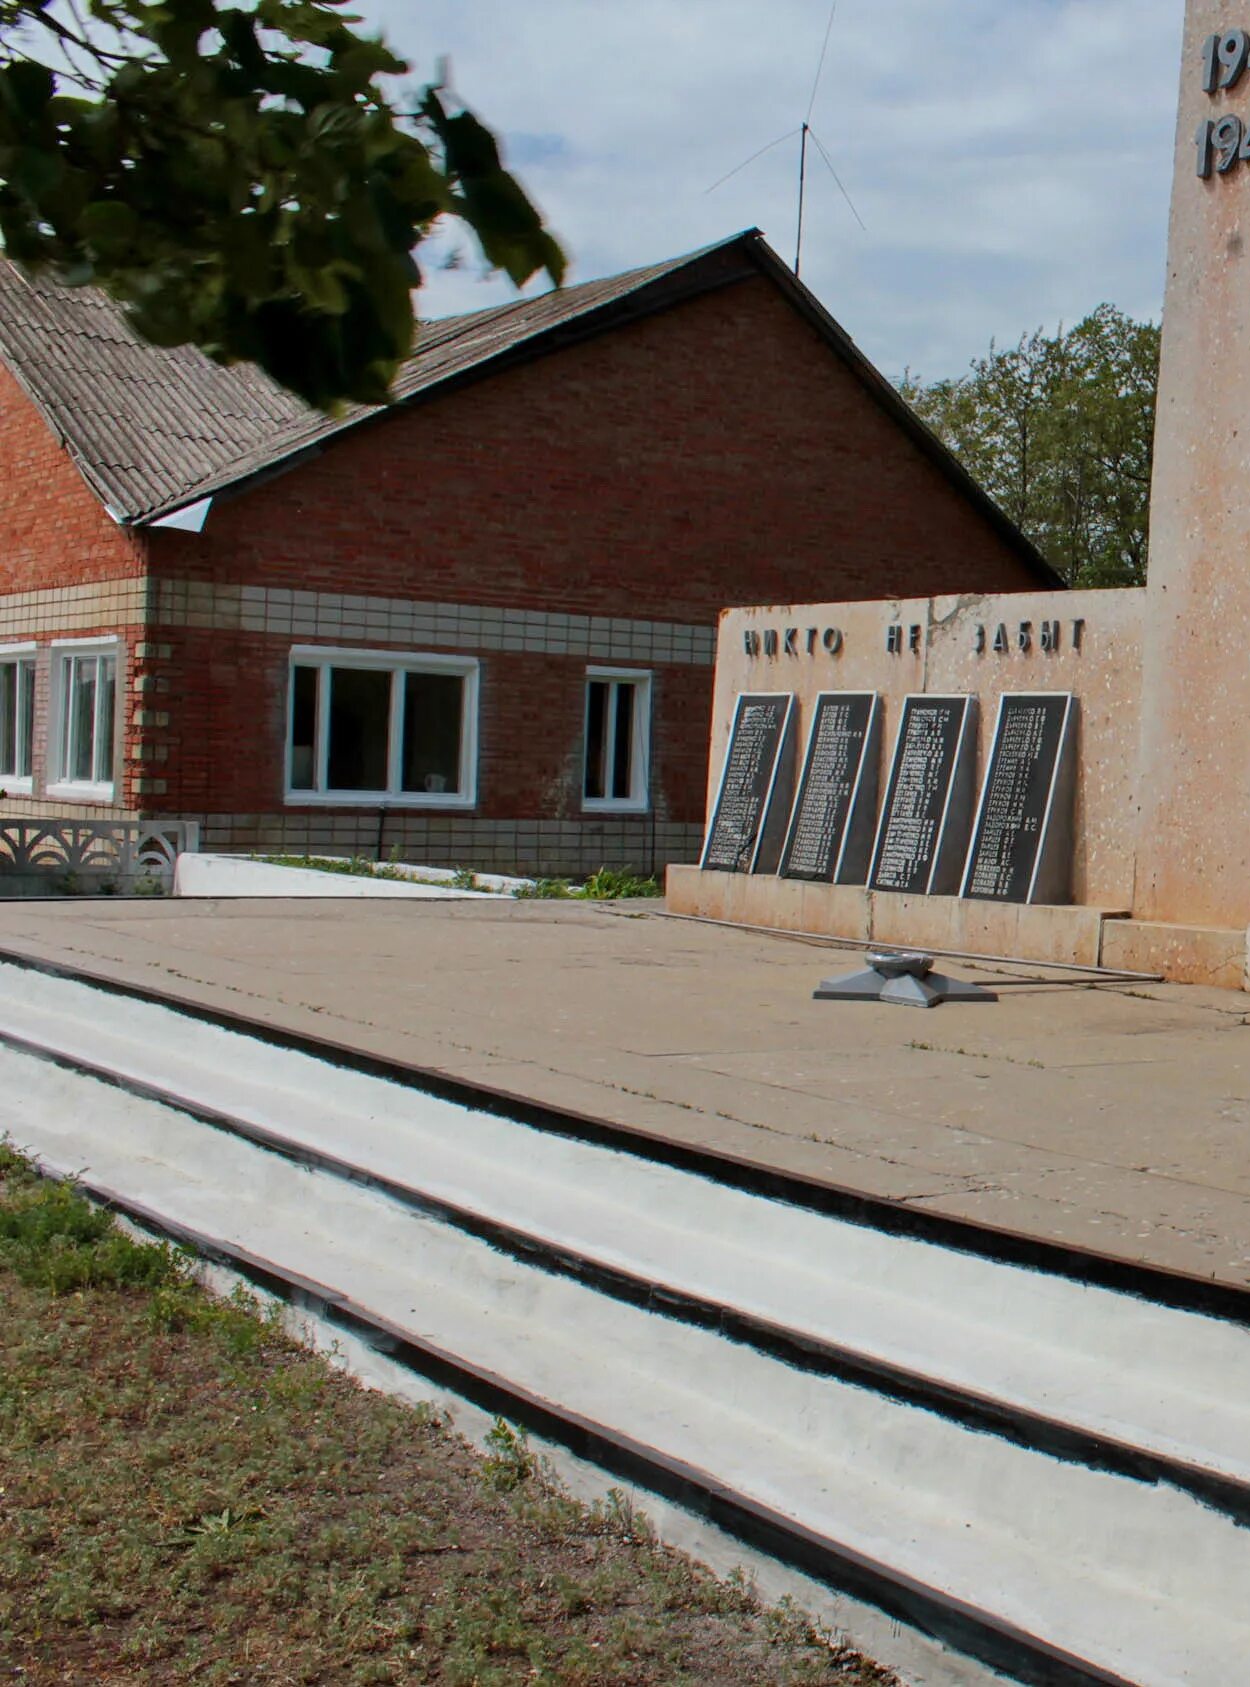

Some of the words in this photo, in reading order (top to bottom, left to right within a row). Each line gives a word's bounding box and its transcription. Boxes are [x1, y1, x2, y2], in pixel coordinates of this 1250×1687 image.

[744, 627, 843, 655] НИКТО
[887, 624, 921, 655] НЕ
[975, 618, 1085, 655] ЗАБЫТ
